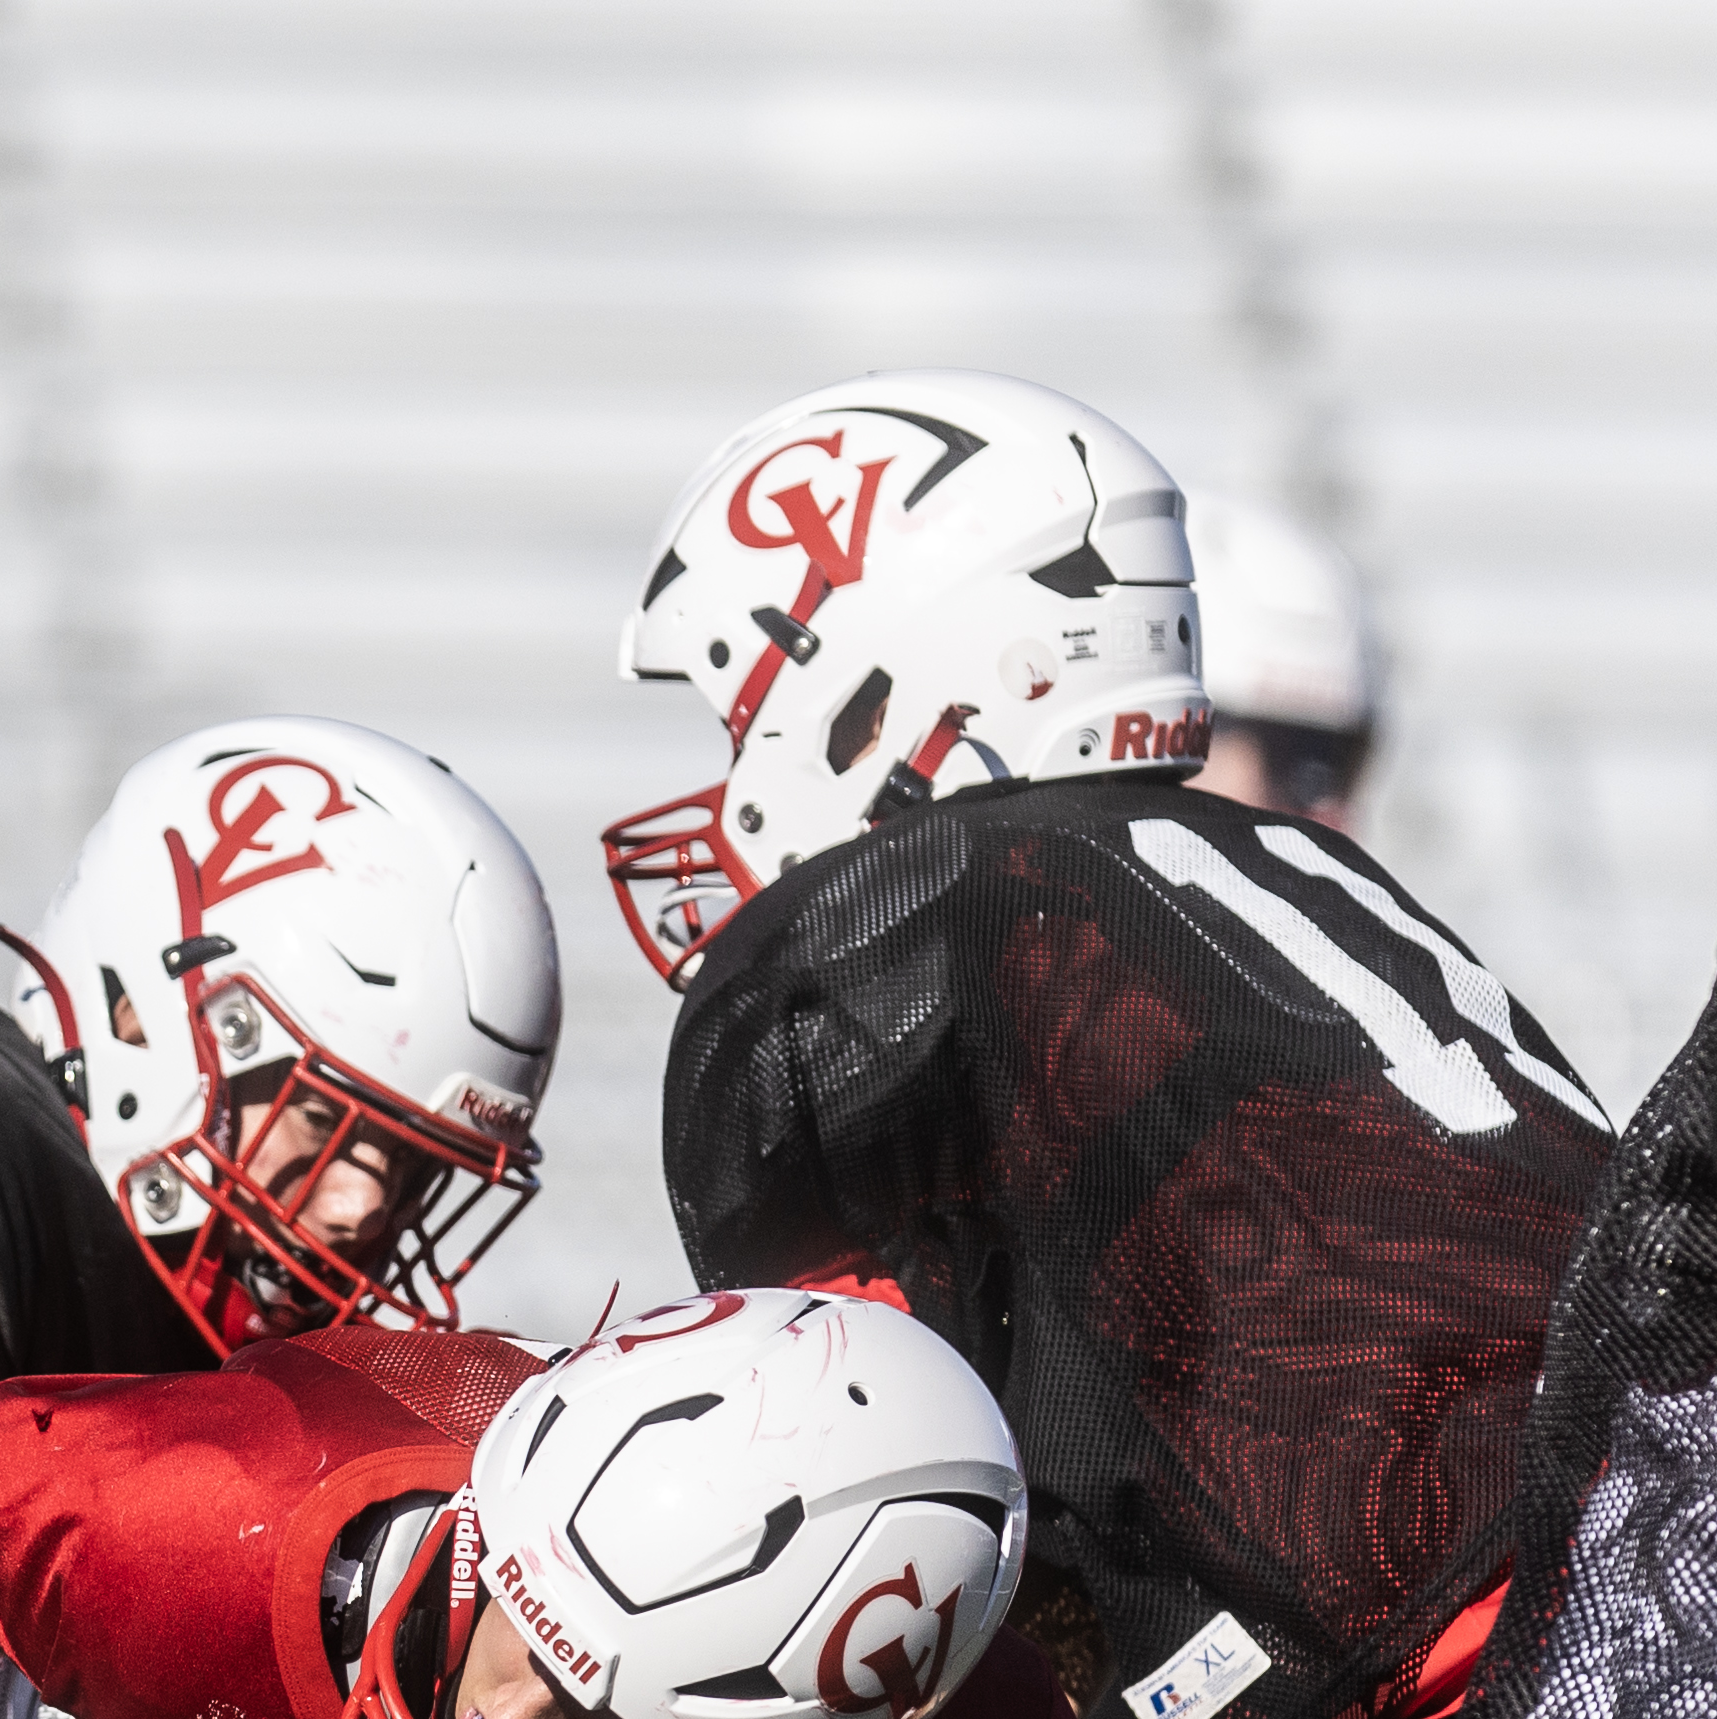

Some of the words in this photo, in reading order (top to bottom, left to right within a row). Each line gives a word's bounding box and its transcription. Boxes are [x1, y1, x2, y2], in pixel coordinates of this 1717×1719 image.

[728, 429, 898, 588] CV
[451, 1488, 480, 1599] Riddell
[496, 1554, 602, 1685] Riddell
[1194, 1643, 1236, 1676] XL
